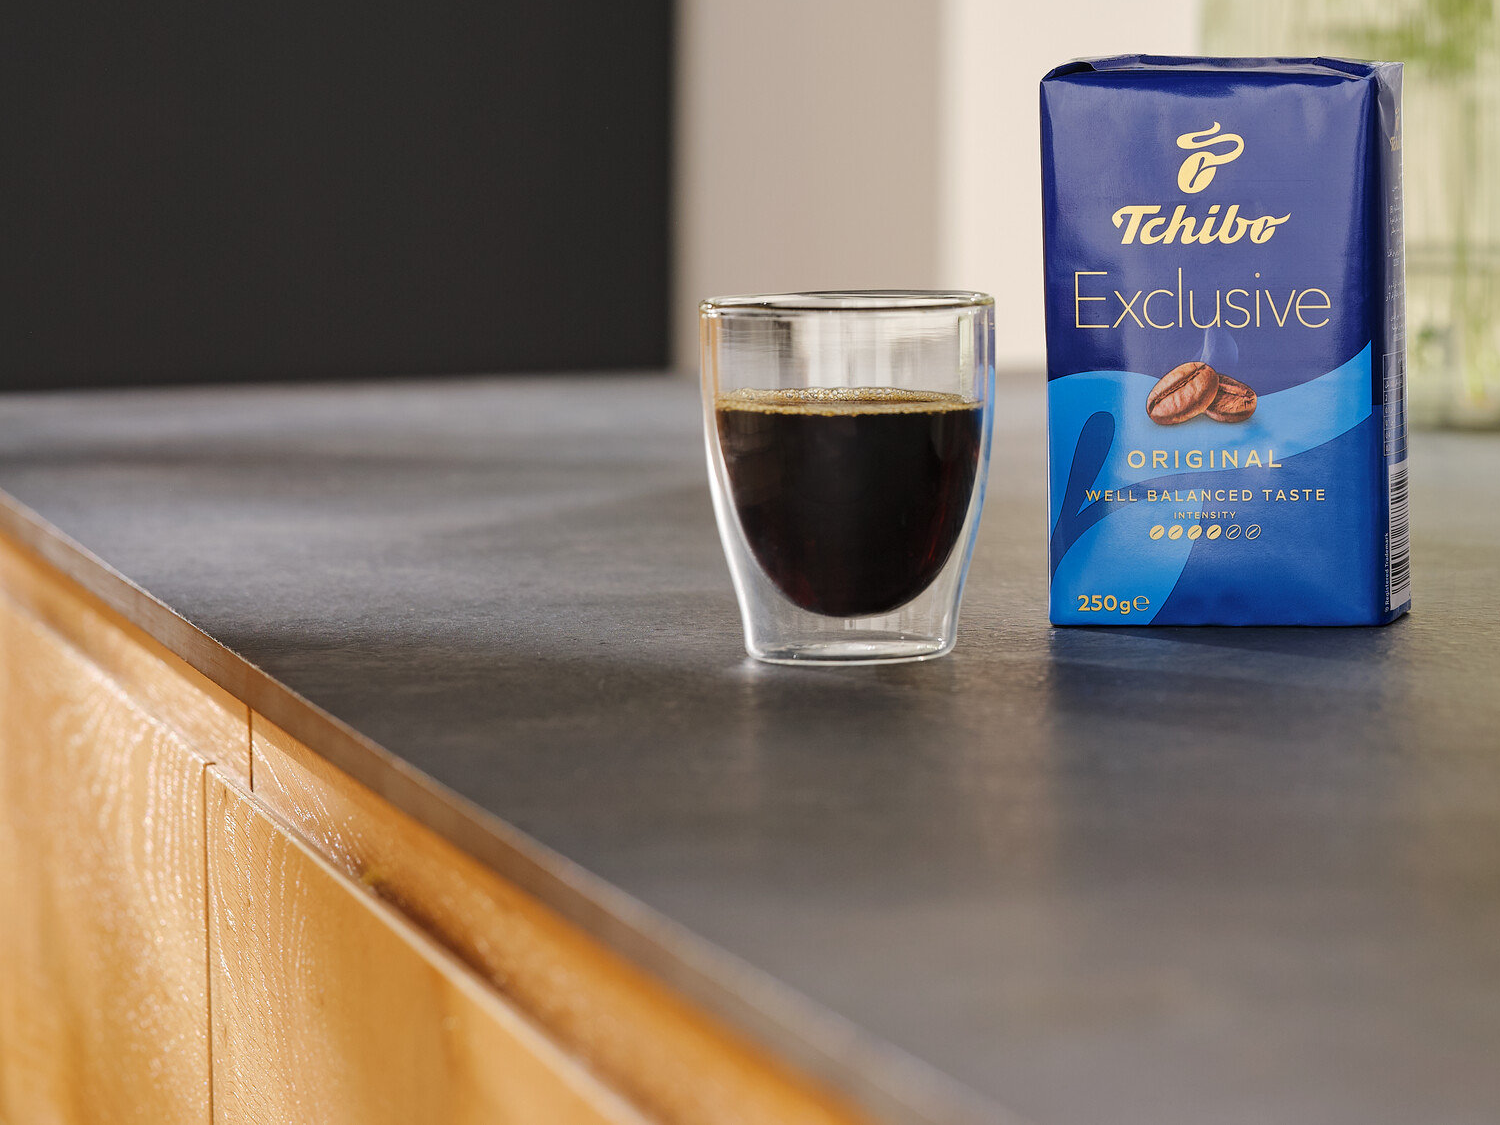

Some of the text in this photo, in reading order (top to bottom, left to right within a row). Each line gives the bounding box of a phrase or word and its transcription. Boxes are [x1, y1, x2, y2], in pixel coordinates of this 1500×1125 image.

[1111, 204, 1292, 245] Tchibo
[1074, 267, 1331, 329] Exclusive
[1127, 449, 1282, 469] ORIGINAL
[1085, 488, 1326, 502] WELL BALANCED TASTE
[1174, 511, 1236, 520] INTENSITY
